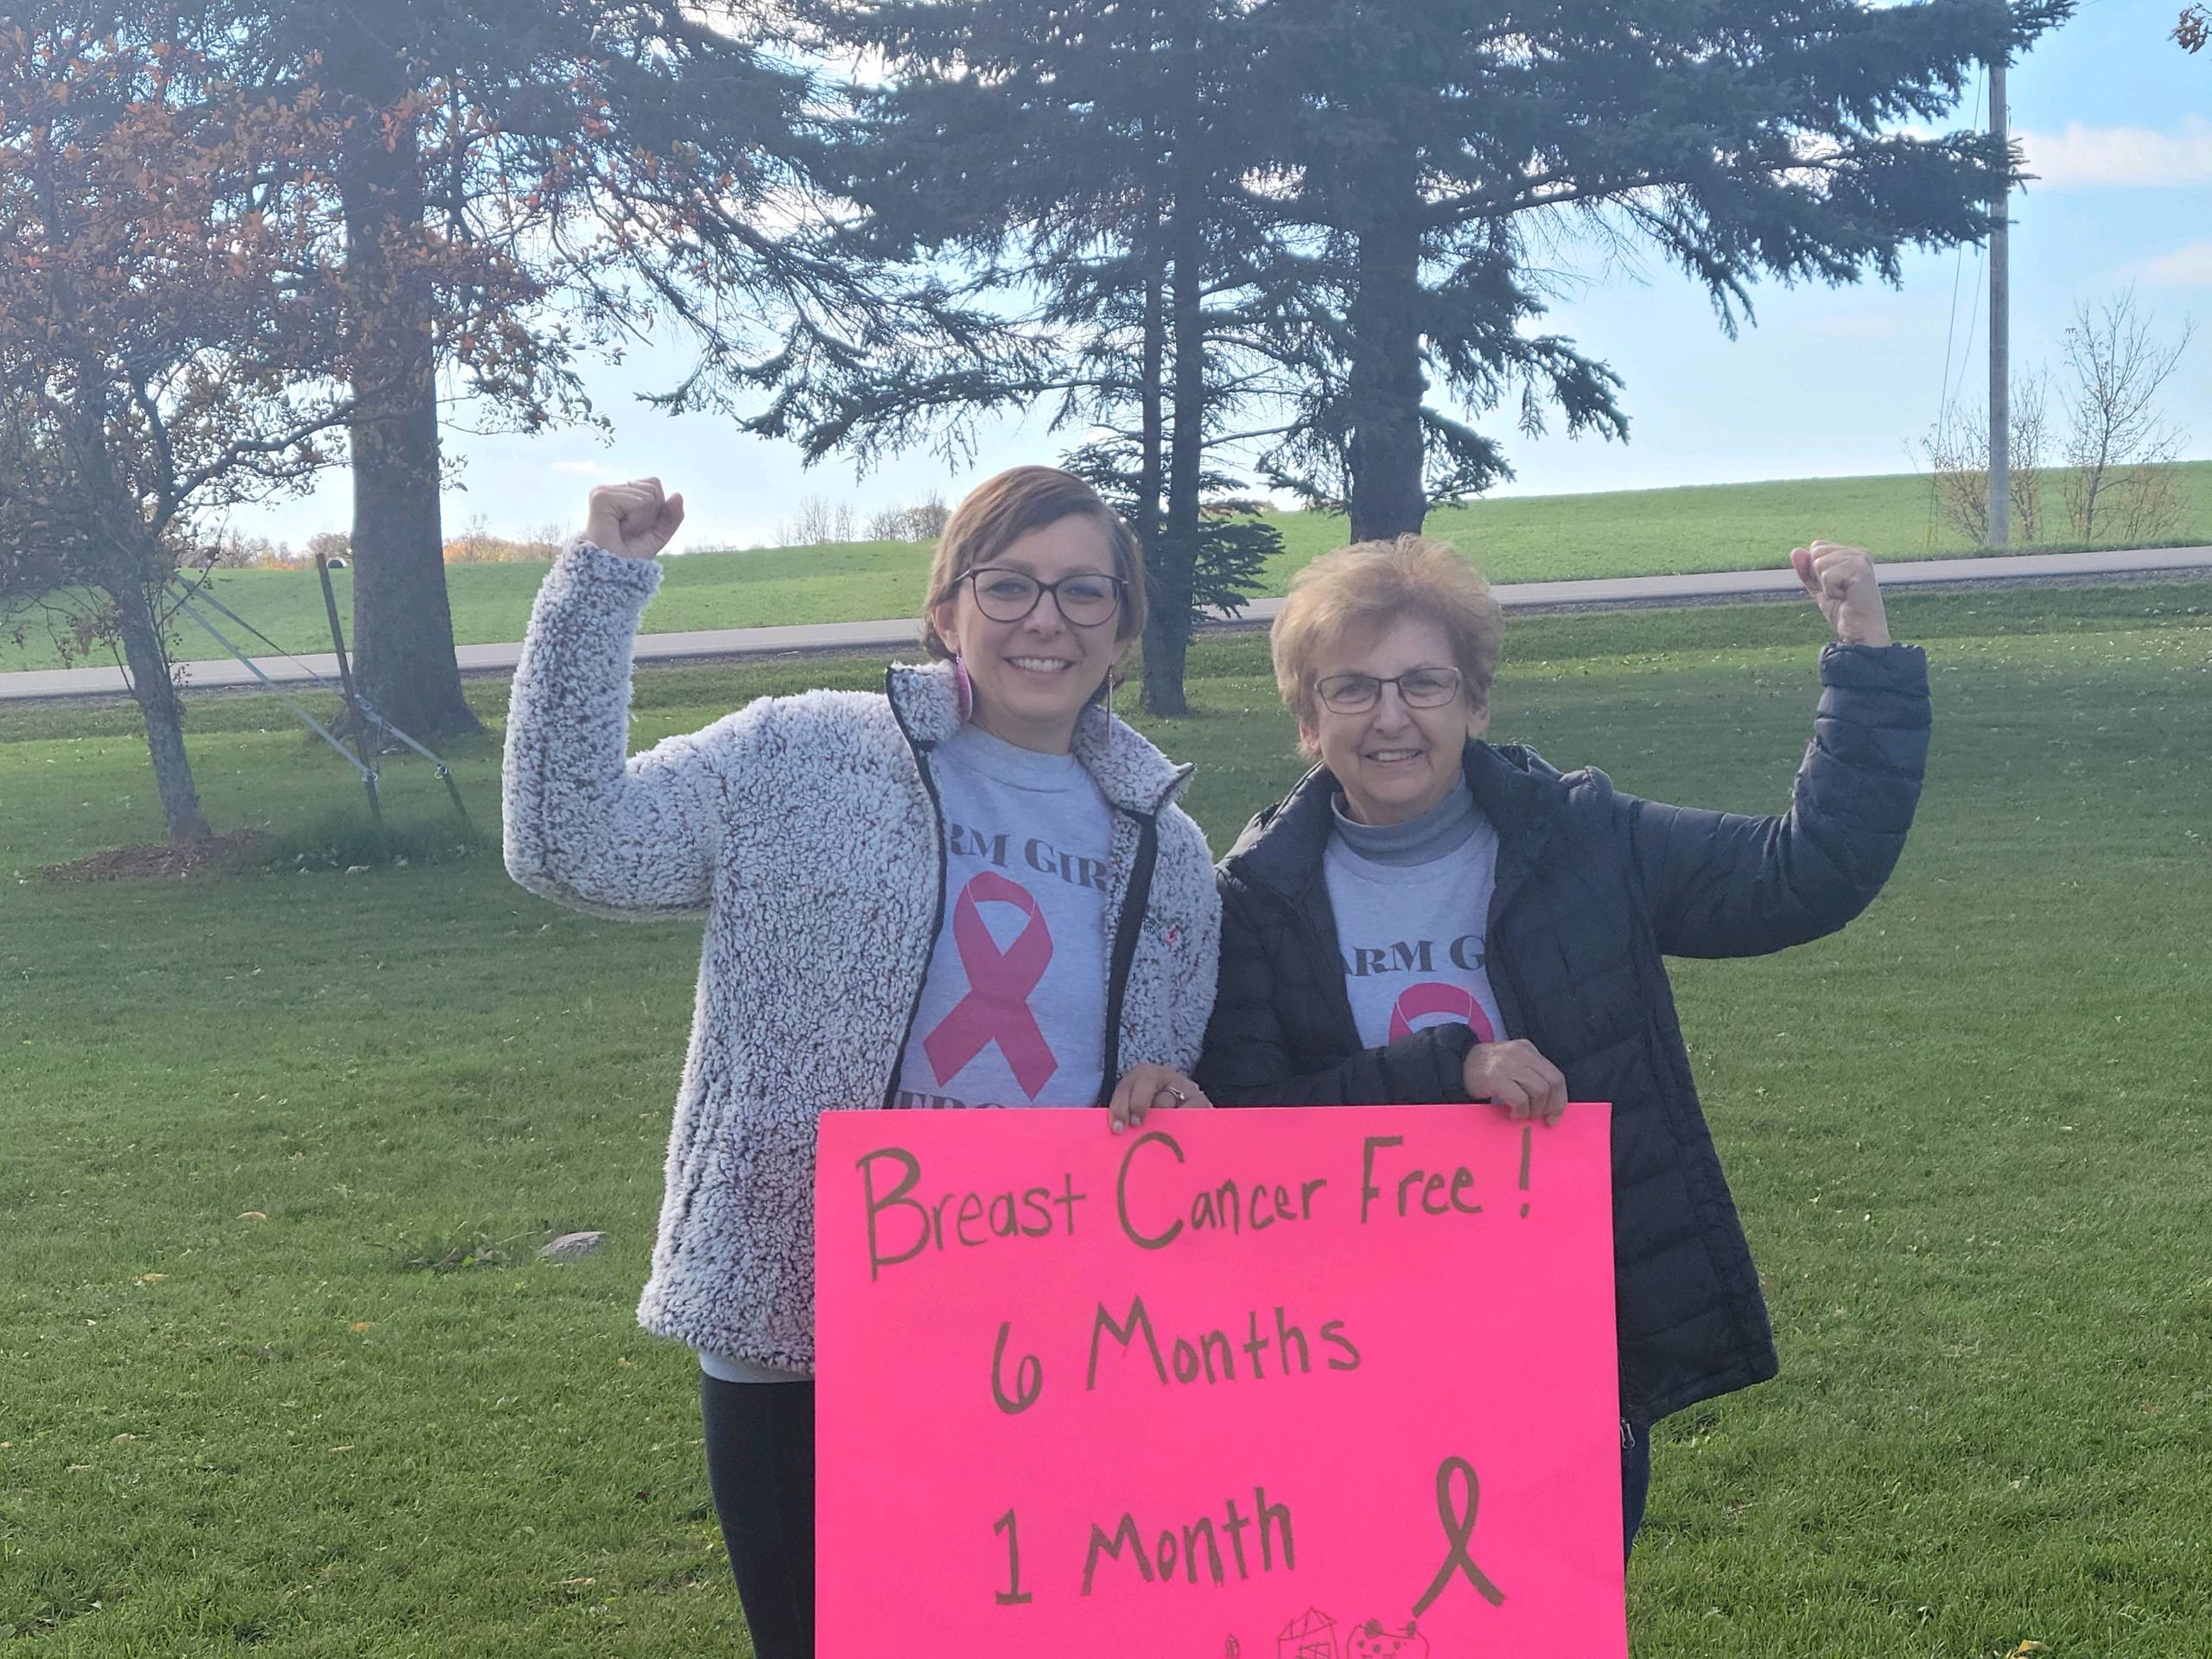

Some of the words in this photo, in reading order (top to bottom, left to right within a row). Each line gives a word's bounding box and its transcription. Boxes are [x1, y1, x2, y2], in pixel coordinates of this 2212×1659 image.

[855, 1147, 1087, 1282] Breast
[1116, 1130, 1328, 1250] Cancer
[1360, 1135, 1484, 1224] Free
[990, 1321, 1044, 1415] 6
[1086, 1294, 1361, 1391] Months
[993, 1508, 1033, 1606] 1
[1081, 1485, 1295, 1597] Month
